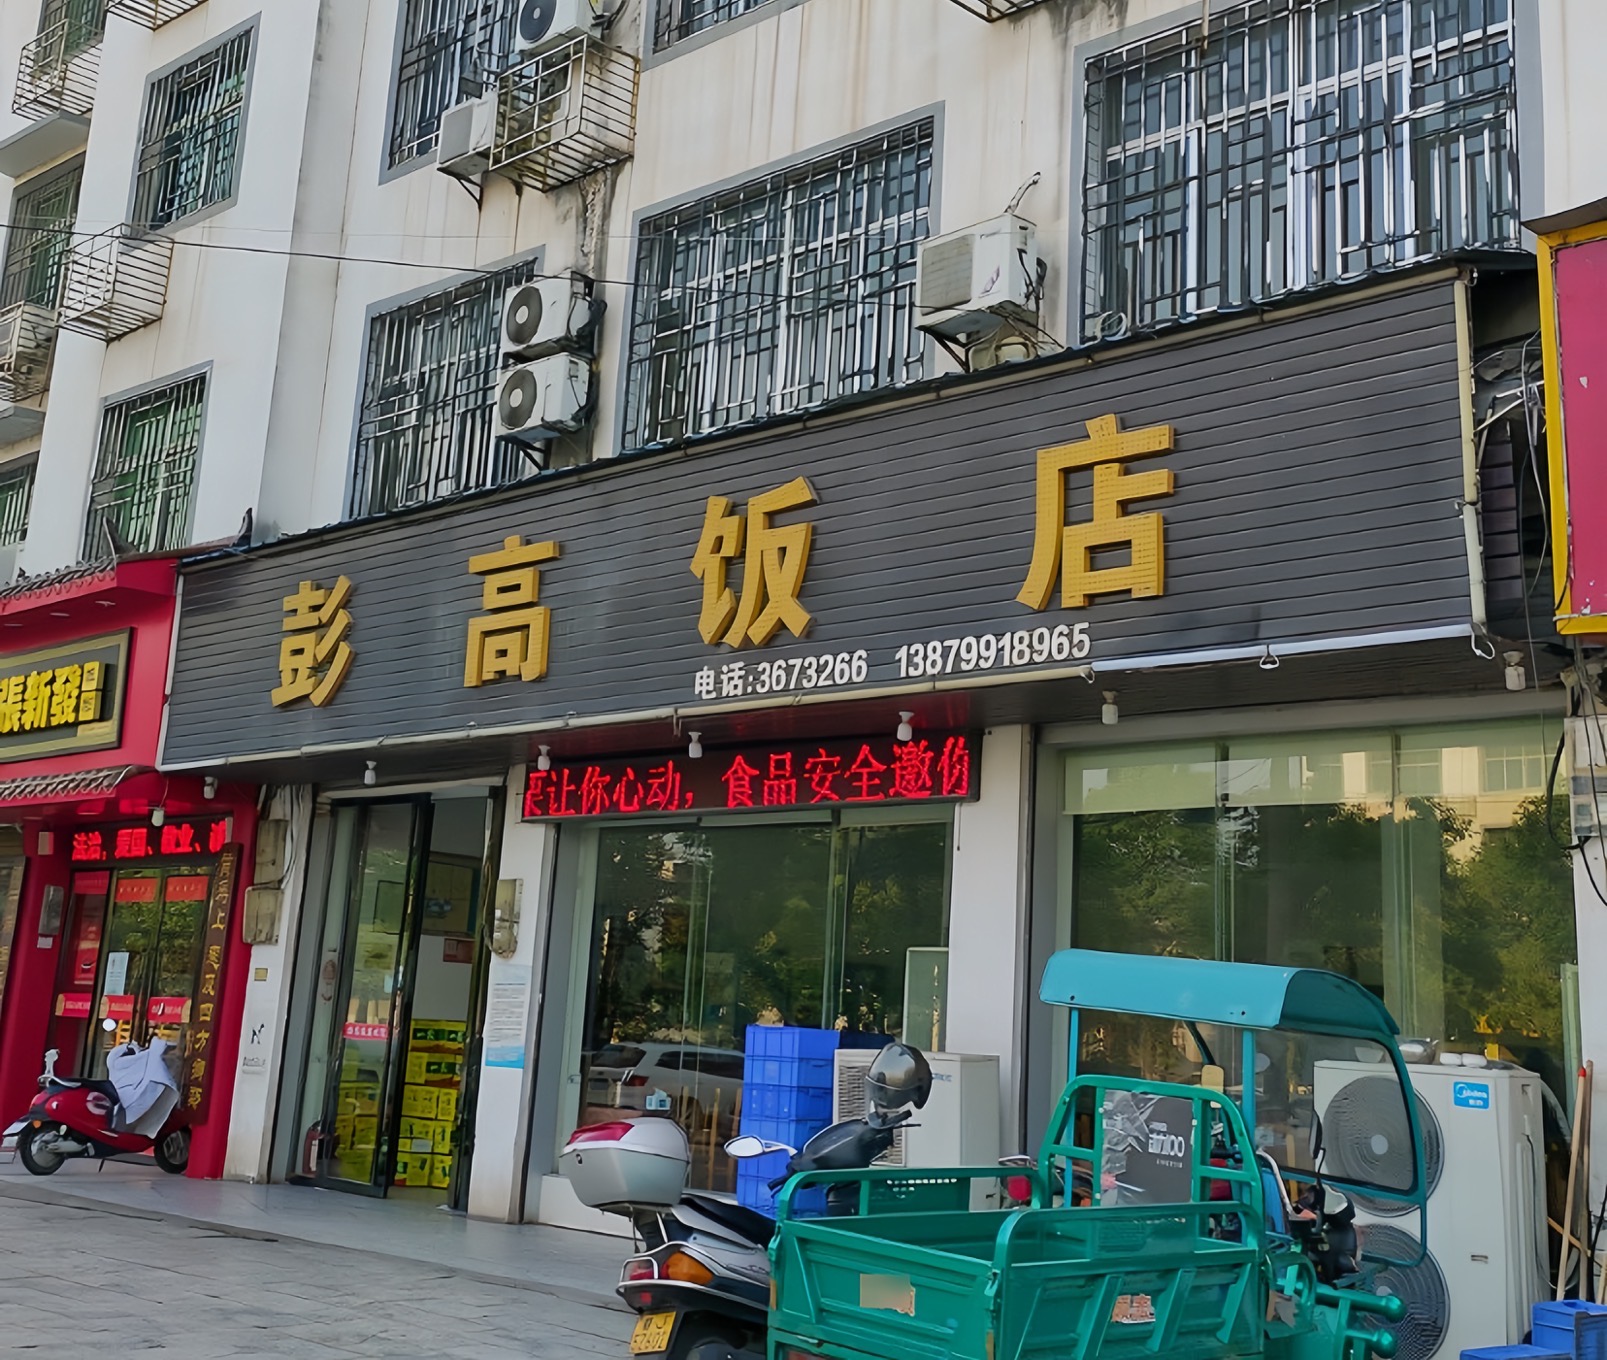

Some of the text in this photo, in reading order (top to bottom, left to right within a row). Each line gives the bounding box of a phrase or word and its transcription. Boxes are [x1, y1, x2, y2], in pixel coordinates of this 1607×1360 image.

[270, 412, 1176, 709] 彭高饭店
[694, 621, 1092, 700] 电话:3673266 13879918965
